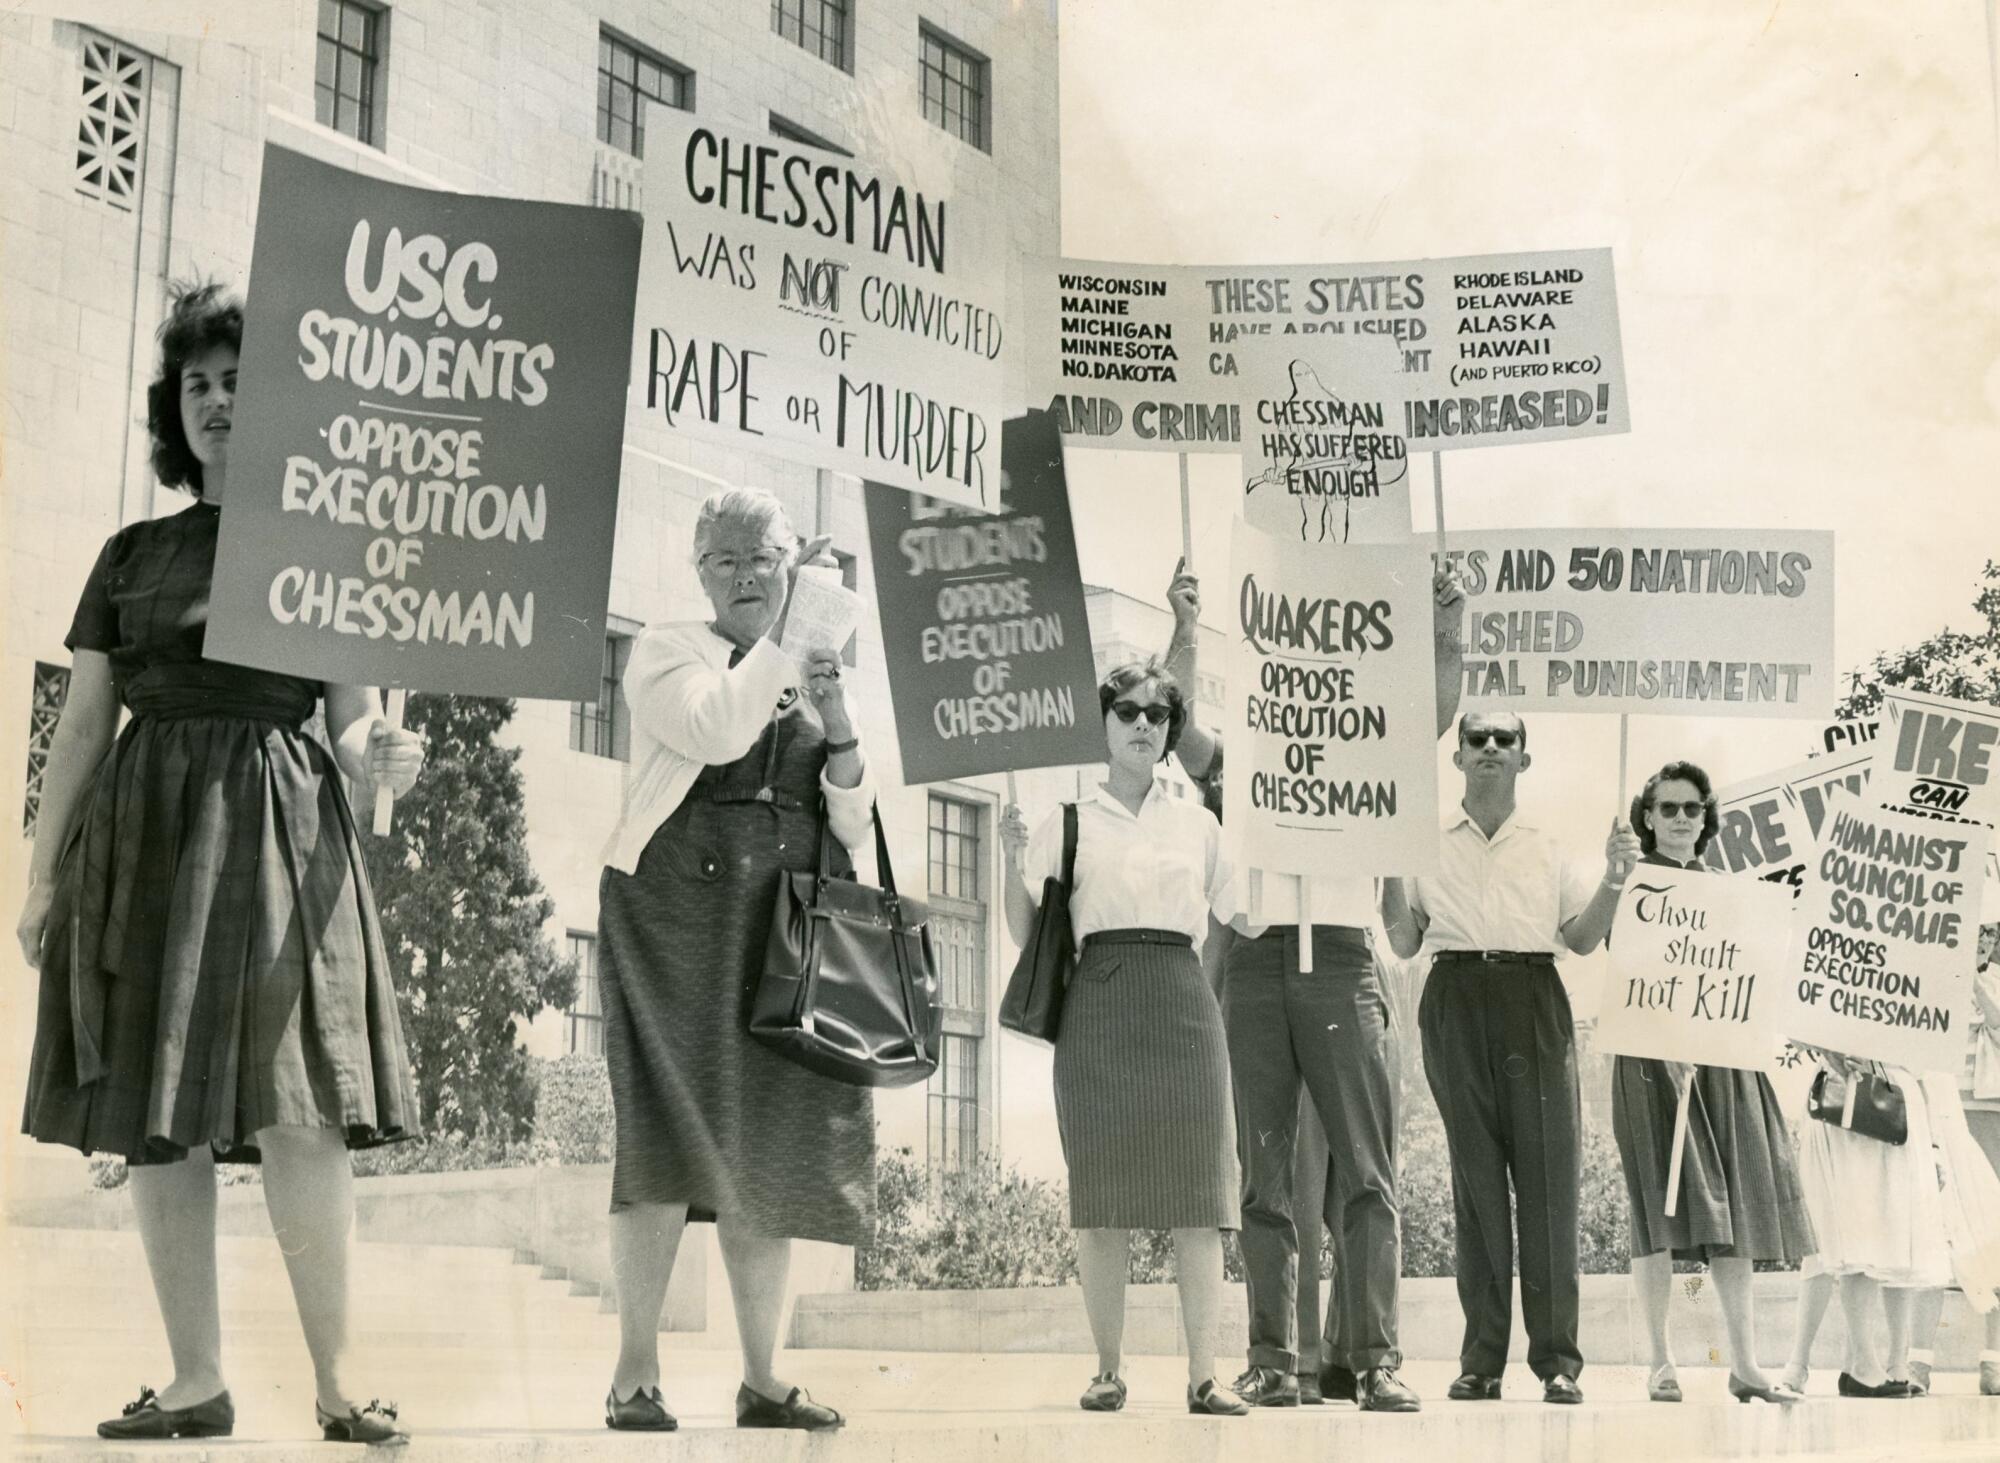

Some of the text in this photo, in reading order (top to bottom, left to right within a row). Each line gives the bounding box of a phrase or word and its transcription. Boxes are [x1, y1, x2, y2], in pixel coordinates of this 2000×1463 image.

[685, 128, 944, 273] CHESSMAN
[345, 219, 501, 329] U.S.C.
[667, 221, 1002, 360] WAS NOT CONVICTED
[1059, 274, 1166, 296] WISCONSIN
[1205, 274, 1424, 315] THESE STATES
[1061, 297, 1129, 315] MAINE
[1457, 290, 1573, 311] DELAWARE
[819, 328, 857, 360] OF
[1061, 317, 1171, 339] MICHIGAN
[1457, 313, 1556, 335] ALASKA
[299, 309, 554, 406] STUDENTS
[1061, 338, 1178, 360] MINNESOTA
[1209, 353, 1239, 376] CA
[1460, 338, 1550, 359] HAWAII
[1450, 355, 1601, 387] (AND PUERTO RICO)
[647, 328, 986, 506] RAPE OR MURDER
[1050, 394, 1123, 436] AND
[1405, 383, 1609, 438] INCREASED!
[1257, 400, 1384, 427] CHESSMAN
[328, 414, 483, 479] OPPOSE
[1262, 433, 1407, 461] HAS SUFFERED
[281, 455, 545, 542] EXECUTION
[1287, 469, 1380, 497] ENOUGH
[365, 537, 423, 580] OF
[1495, 548, 1555, 593] AND
[1567, 547, 1624, 592] 50
[1630, 548, 1812, 598] NATIONS
[269, 566, 534, 649] CHESSMAN
[937, 577, 1032, 621] OPPOSE
[1240, 573, 1394, 661] QUAKERS
[921, 613, 1063, 663] EXECUTION
[973, 661, 1011, 696] OF
[1261, 661, 1355, 703] OPPOSE
[1547, 659, 1812, 703] PUNISHMENT
[934, 685, 1075, 739] CHESSMAN
[1247, 694, 1386, 741] EXECUTION
[1285, 743, 1324, 775] OF
[1894, 709, 1999, 785] IKE
[1252, 771, 1397, 819] CHESSMAN
[1909, 783, 1970, 810] CAN
[1830, 811, 1968, 873] HUMANIST
[1820, 849, 1930, 907] COUNCIL
[1932, 881, 1963, 905] OF
[1628, 882, 1708, 930] Thou
[1829, 889, 1872, 932] SO.
[1664, 935, 1741, 971] shalt
[1808, 927, 1886, 966] OPPOSES
[1804, 954, 1920, 998] EXECUTION
[1625, 974, 1755, 1023] not kill
[1799, 980, 1950, 1033] OF CHESSMAN
